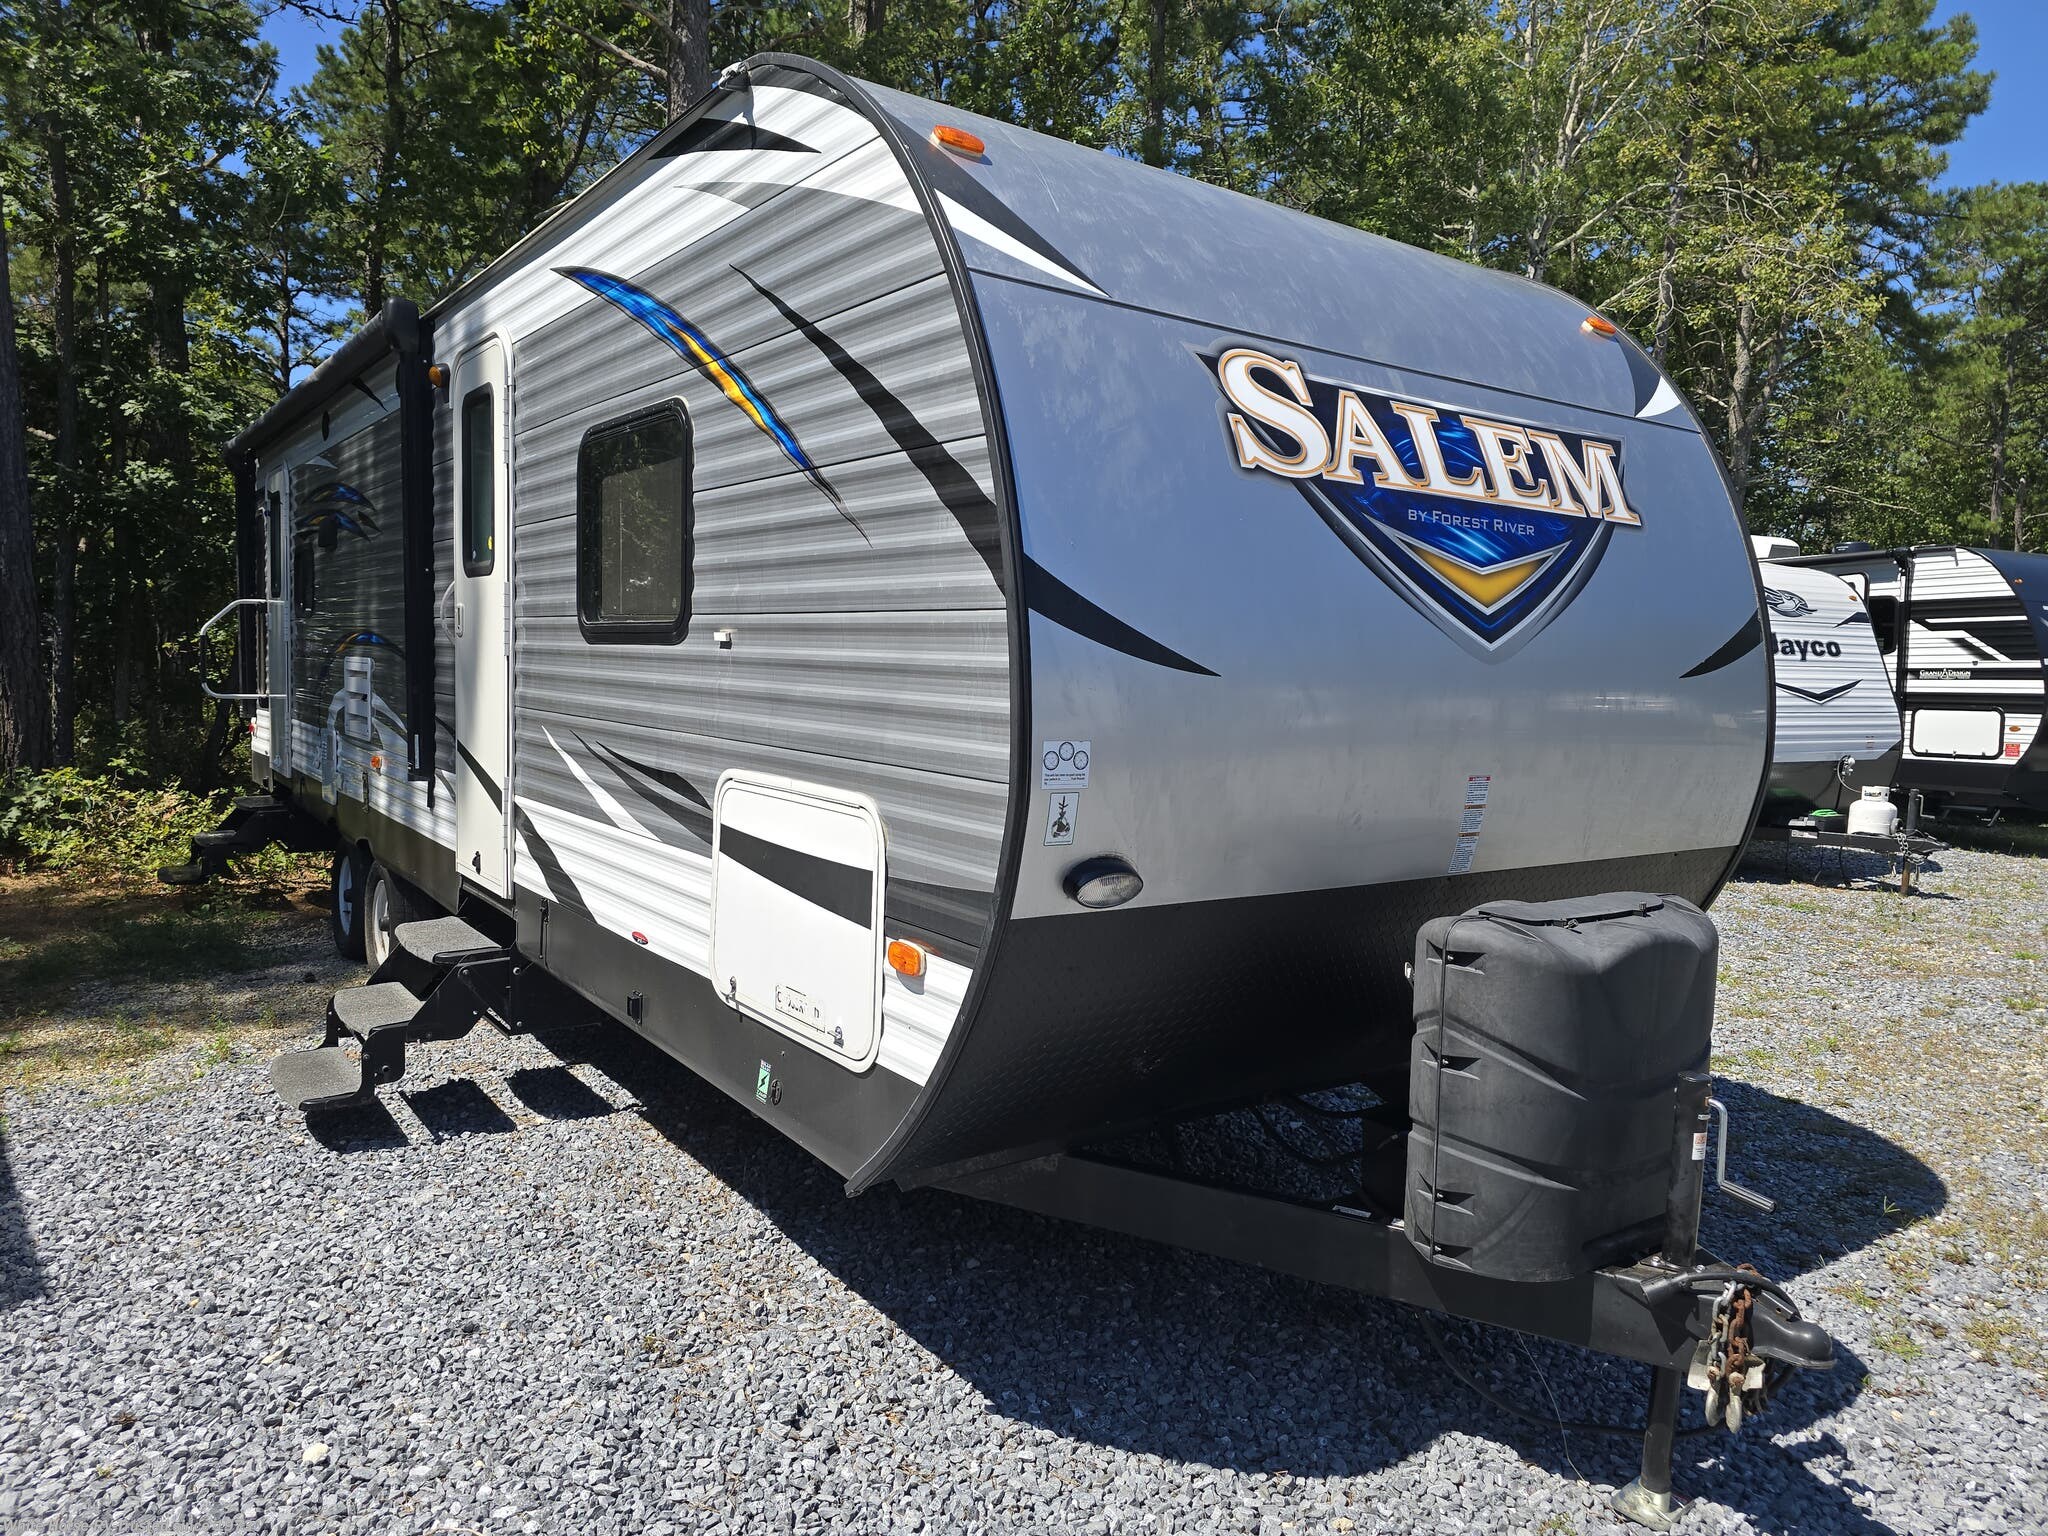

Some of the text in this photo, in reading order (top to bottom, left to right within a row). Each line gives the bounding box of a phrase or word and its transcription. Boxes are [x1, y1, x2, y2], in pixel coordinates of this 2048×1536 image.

[1218, 348, 1642, 526] SALEM
[1408, 509, 1535, 536] BY FOREST RIVER
